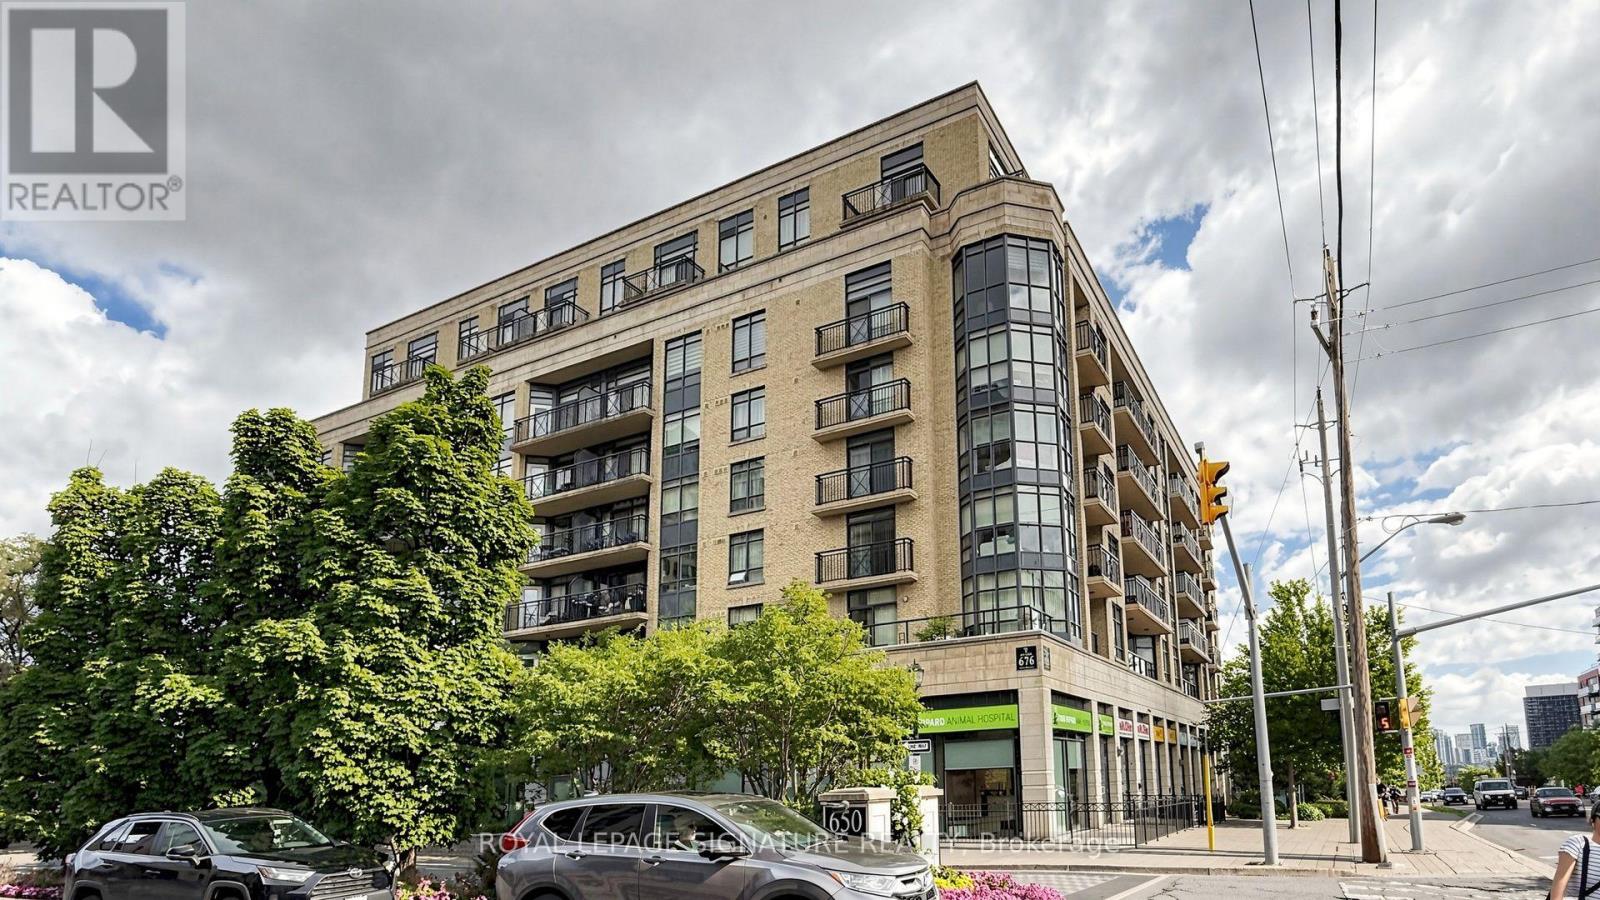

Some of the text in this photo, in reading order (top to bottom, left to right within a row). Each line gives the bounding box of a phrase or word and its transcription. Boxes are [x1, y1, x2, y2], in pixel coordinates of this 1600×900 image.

[1018, 655, 1035, 667] 676
[947, 716, 975, 726] ANIMAL
[977, 713, 1014, 723] HOSPITAL
[829, 809, 863, 833] 650
